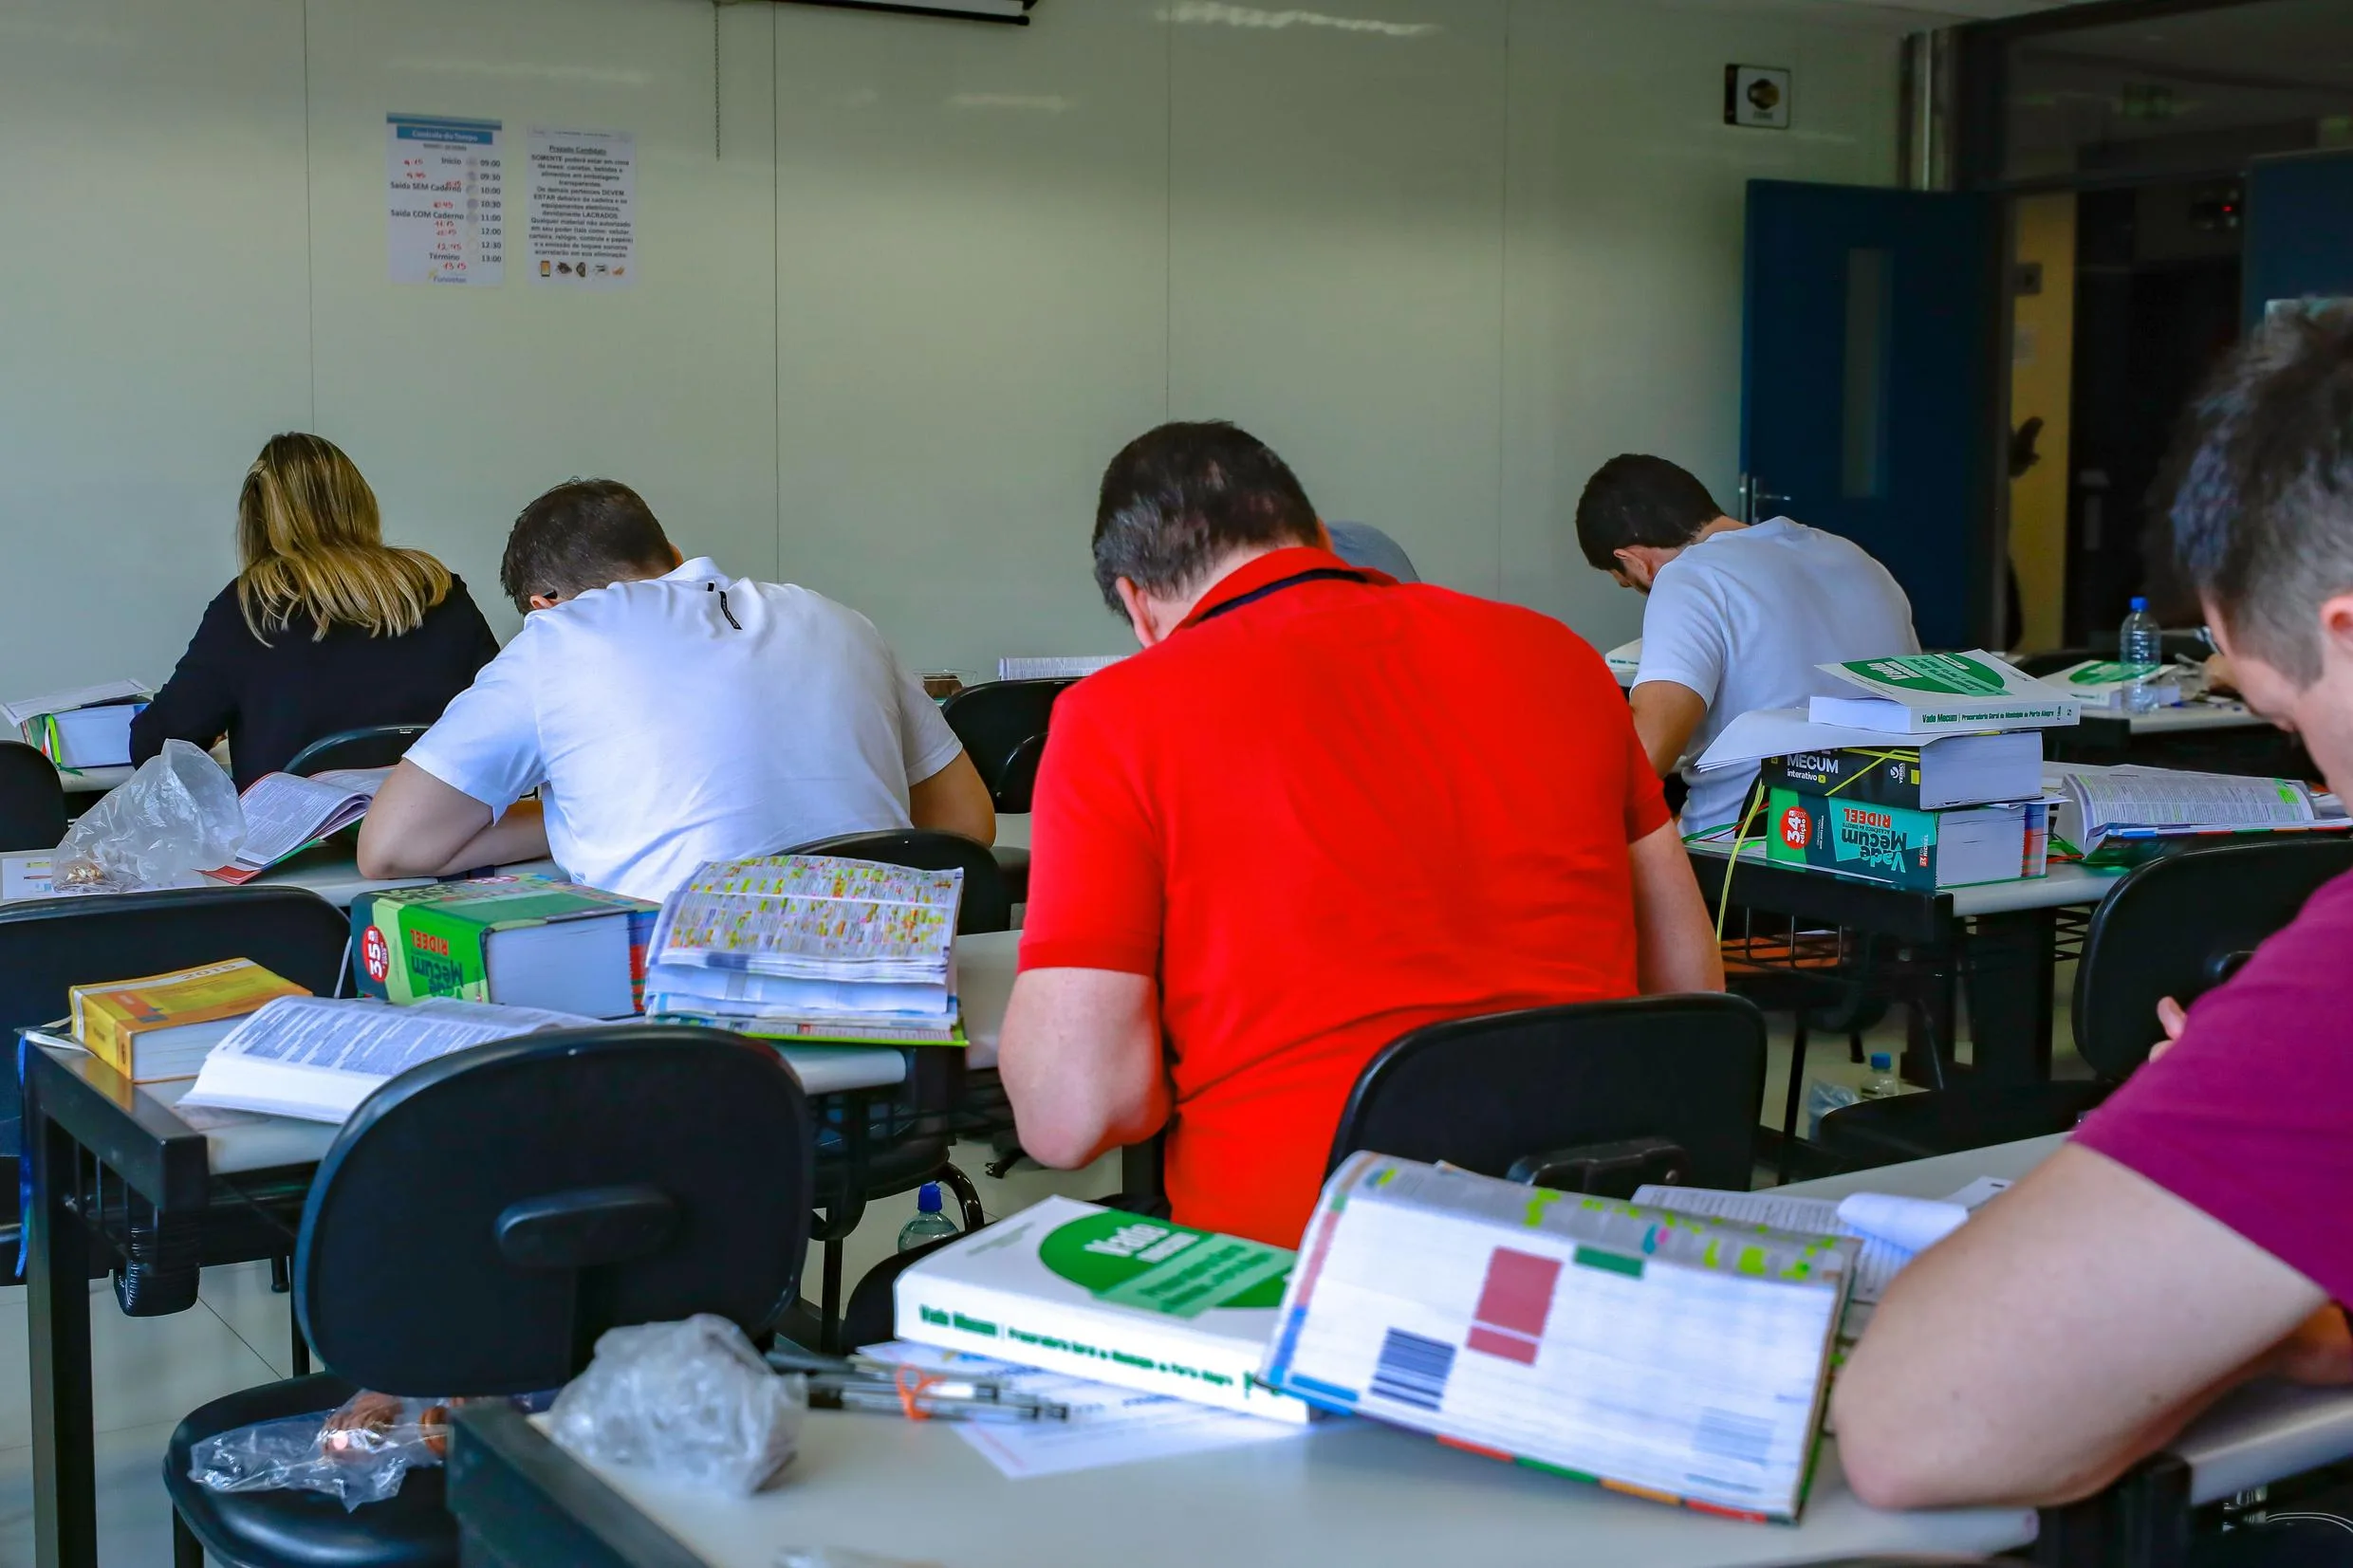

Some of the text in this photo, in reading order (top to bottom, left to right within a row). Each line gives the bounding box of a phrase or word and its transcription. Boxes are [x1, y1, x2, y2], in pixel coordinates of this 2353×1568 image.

[441, 157, 462, 165] Início
[431, 184, 461, 193] Caderno
[481, 186, 501, 194] 10:00
[1922, 714, 1936, 723] Vade
[1937, 713, 1957, 723] Mecum
[2041, 710, 2054, 718] Alegre
[1787, 753, 1839, 774] MECUM
[1787, 768, 1818, 781] interativo
[1843, 808, 1891, 829] RIDEEL
[1841, 828, 1907, 852] Mecum
[1860, 846, 1906, 874] Vade
[410, 930, 449, 956] RIDEEL
[412, 955, 464, 988] Mecum
